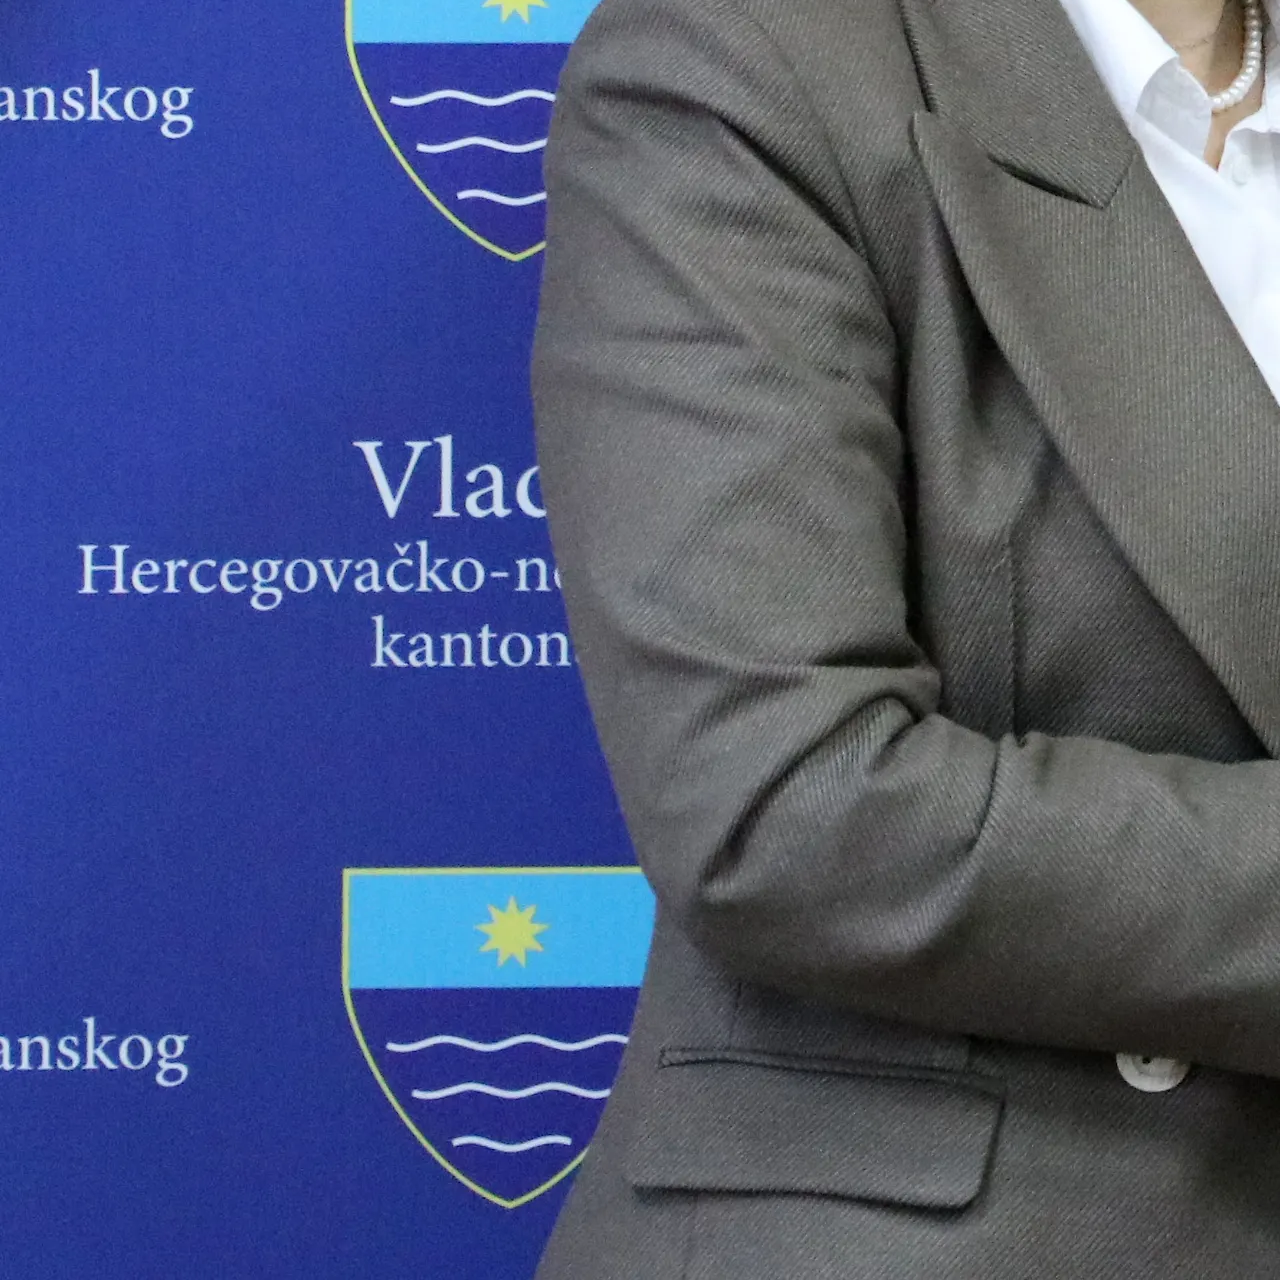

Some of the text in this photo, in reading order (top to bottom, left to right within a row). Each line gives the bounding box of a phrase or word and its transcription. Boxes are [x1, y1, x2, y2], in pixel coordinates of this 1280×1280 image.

[0, 68, 195, 140] anskog
[352, 434, 548, 519] Vla
[78, 540, 562, 611] Hercegovačko-n
[370, 614, 580, 668] kanton
